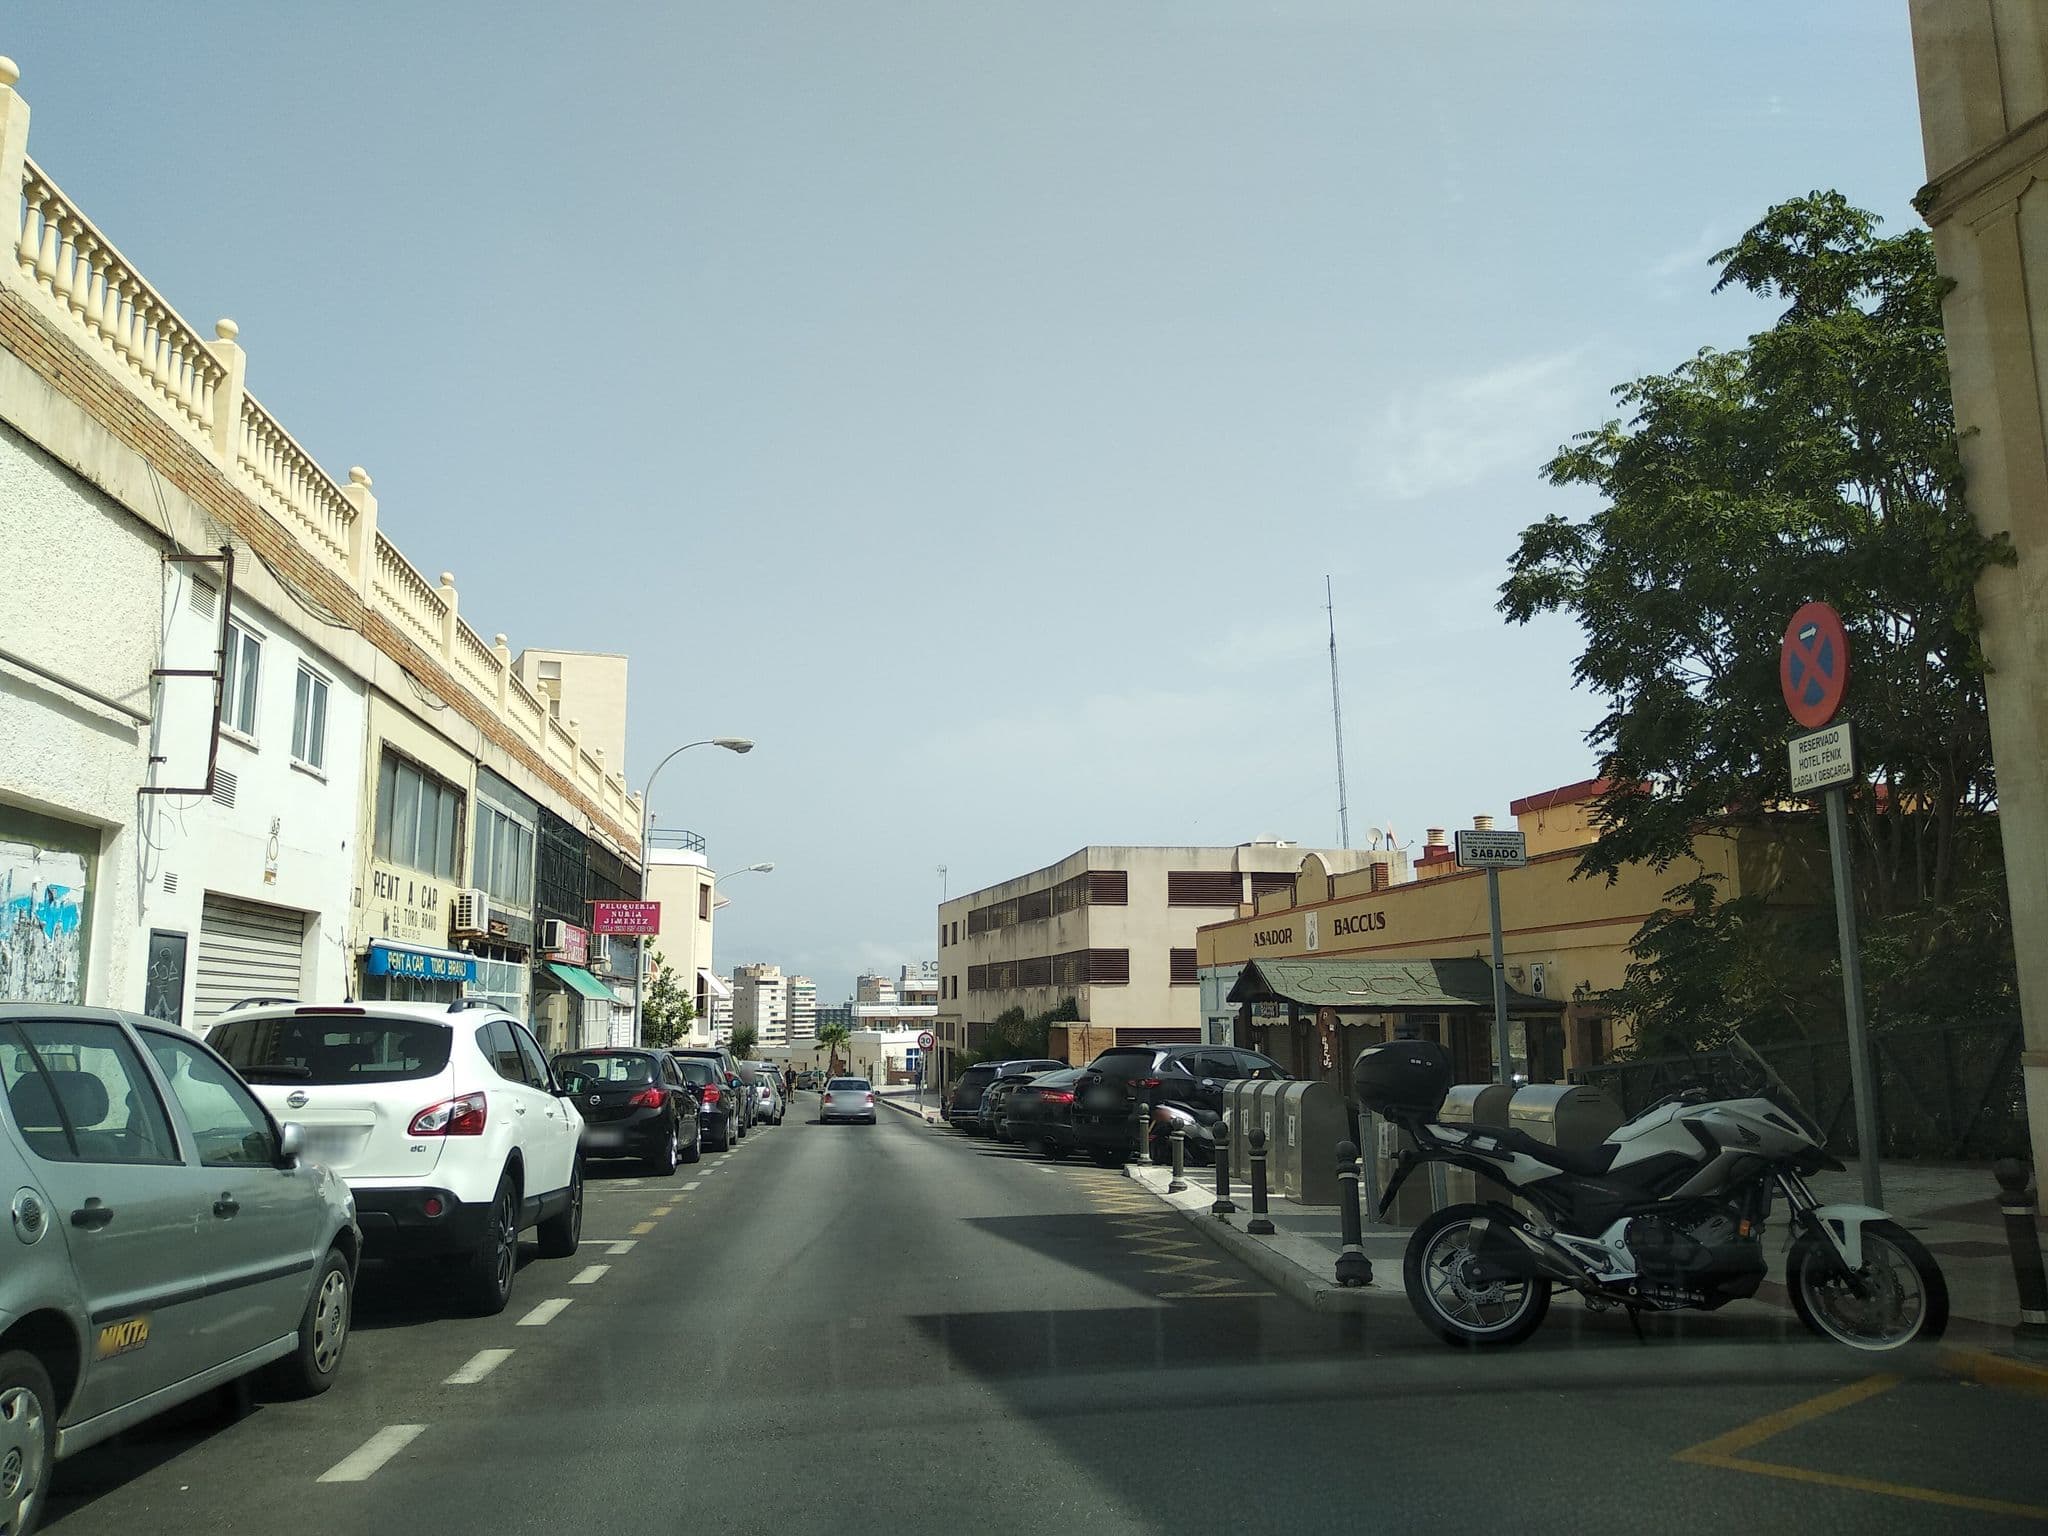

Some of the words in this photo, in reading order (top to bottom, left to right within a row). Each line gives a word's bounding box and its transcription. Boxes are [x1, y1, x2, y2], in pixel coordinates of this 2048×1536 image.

[1799, 731, 1839, 753] RESERVADO
[1799, 755, 1821, 770] HOTEL
[1793, 773, 1813, 788] CARGA
[1818, 763, 1851, 781] DESCARGA
[1471, 849, 1518, 858] SABADO
[374, 871, 400, 901] RENT
[408, 881, 414, 905] A
[421, 885, 438, 911] CAR
[393, 906, 399, 923] EL
[404, 908, 418, 928] TORO
[421, 912, 437, 931] BRAVO
[1253, 928, 1292, 947] ASADOR
[1334, 911, 1386, 936] BACCUS
[388, 951, 405, 970] RENT
[405, 955, 412, 972] A
[412, 955, 425, 973] CAR
[431, 957, 446, 975] TORO
[447, 959, 467, 977] BRAVO
[920, 1037, 931, 1045] 30
